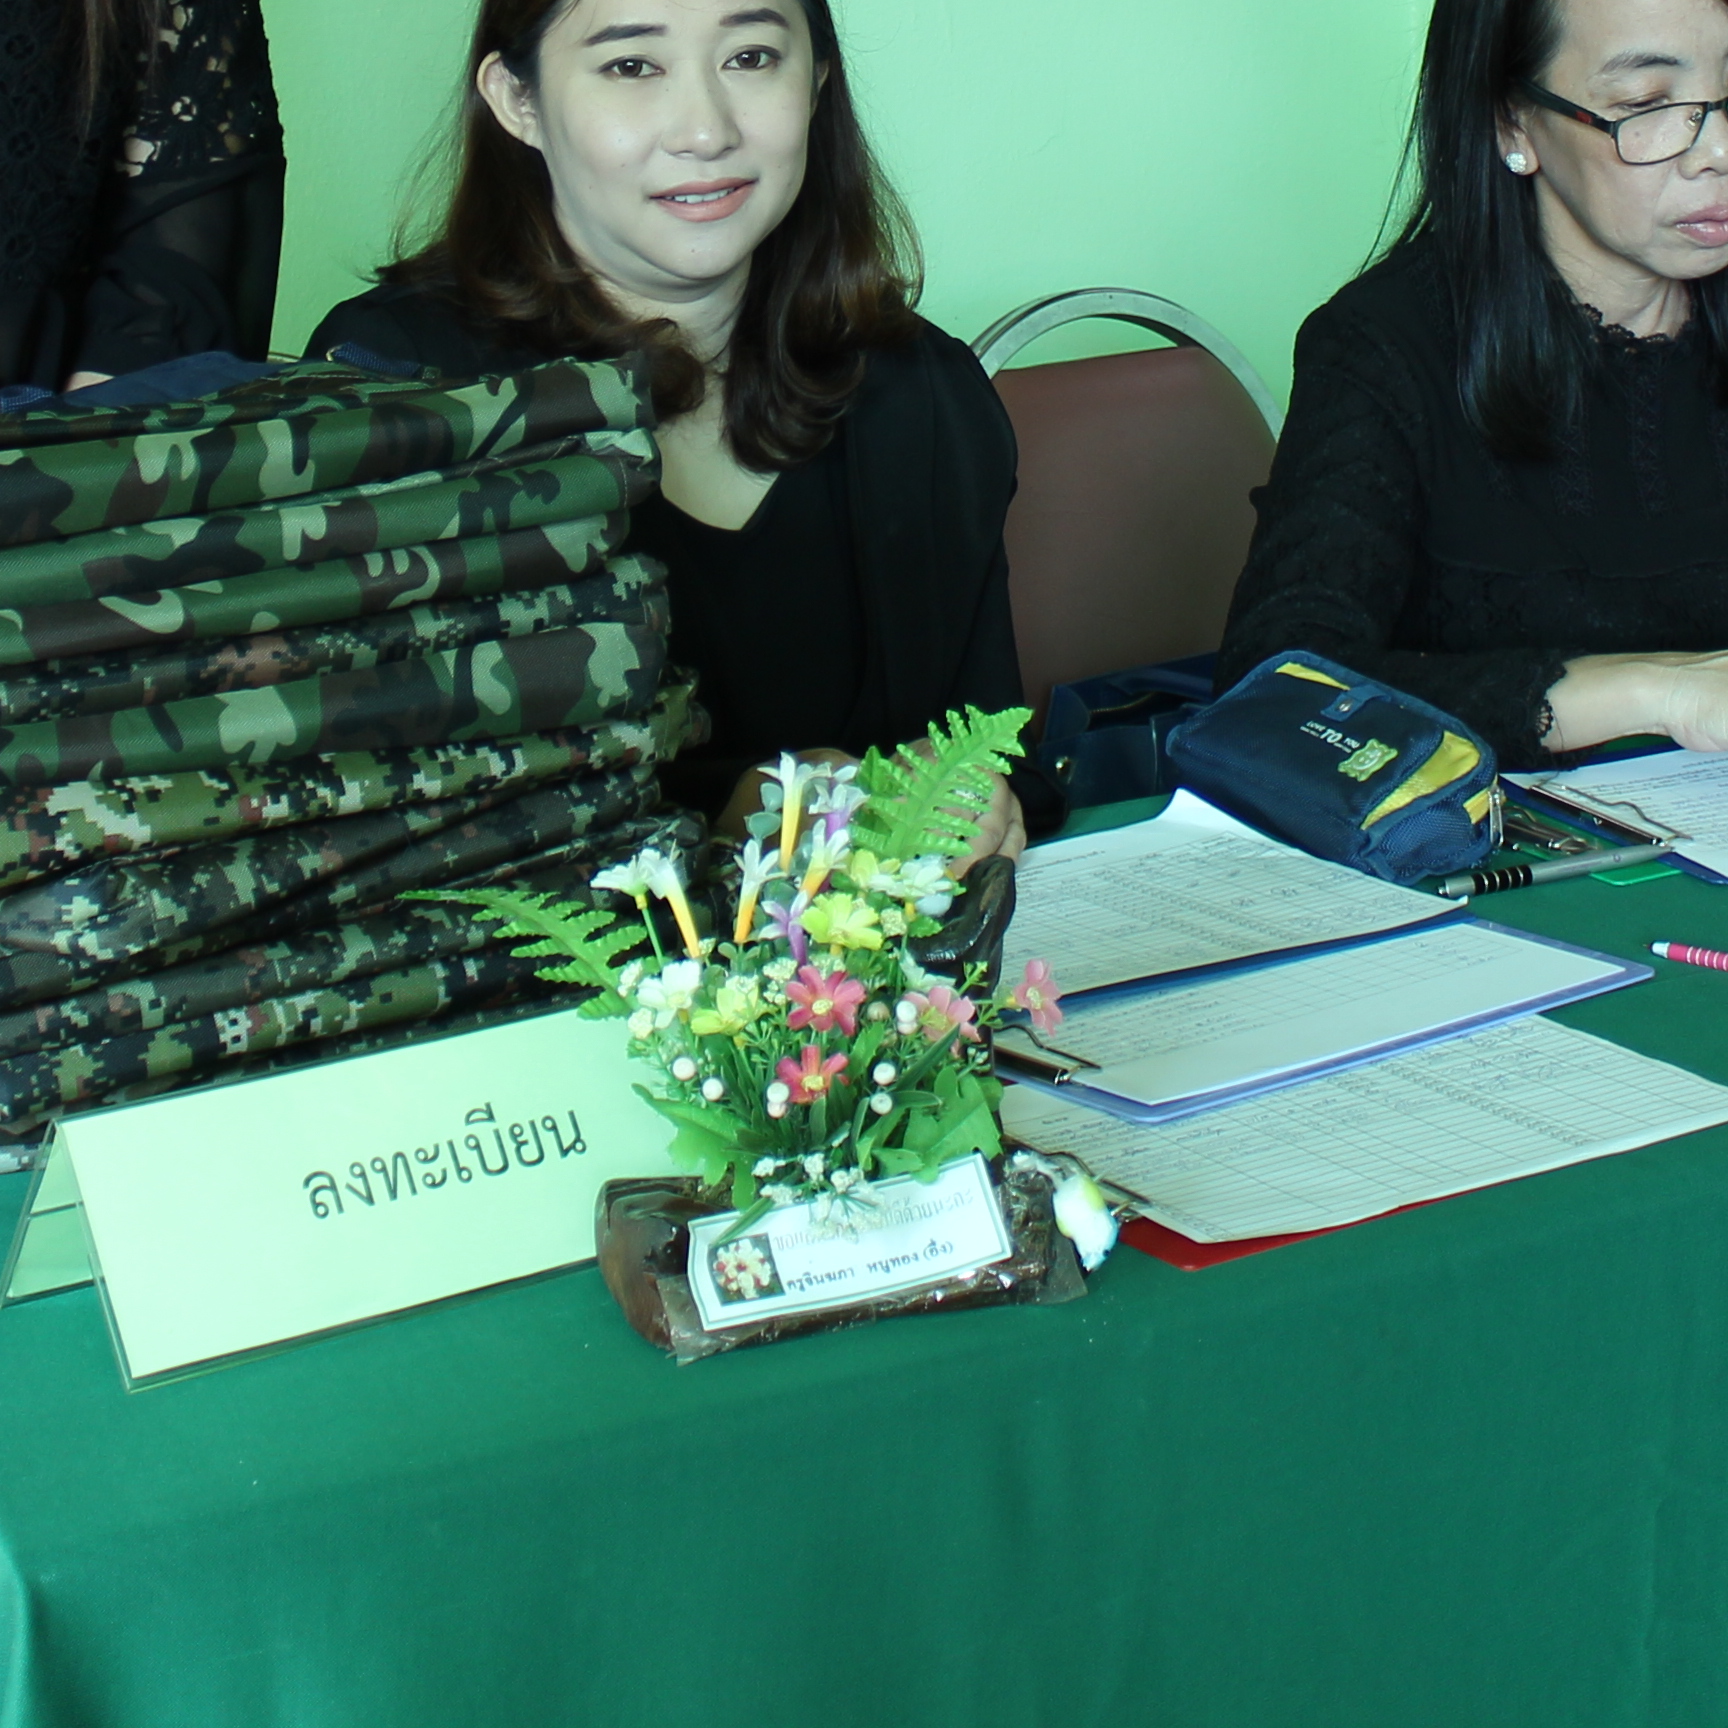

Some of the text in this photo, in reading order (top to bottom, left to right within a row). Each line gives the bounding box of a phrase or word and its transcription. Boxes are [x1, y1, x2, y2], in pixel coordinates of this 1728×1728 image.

[1319, 728, 1343, 744] TO
[302, 1101, 588, 1220] ลงทะเบียน
